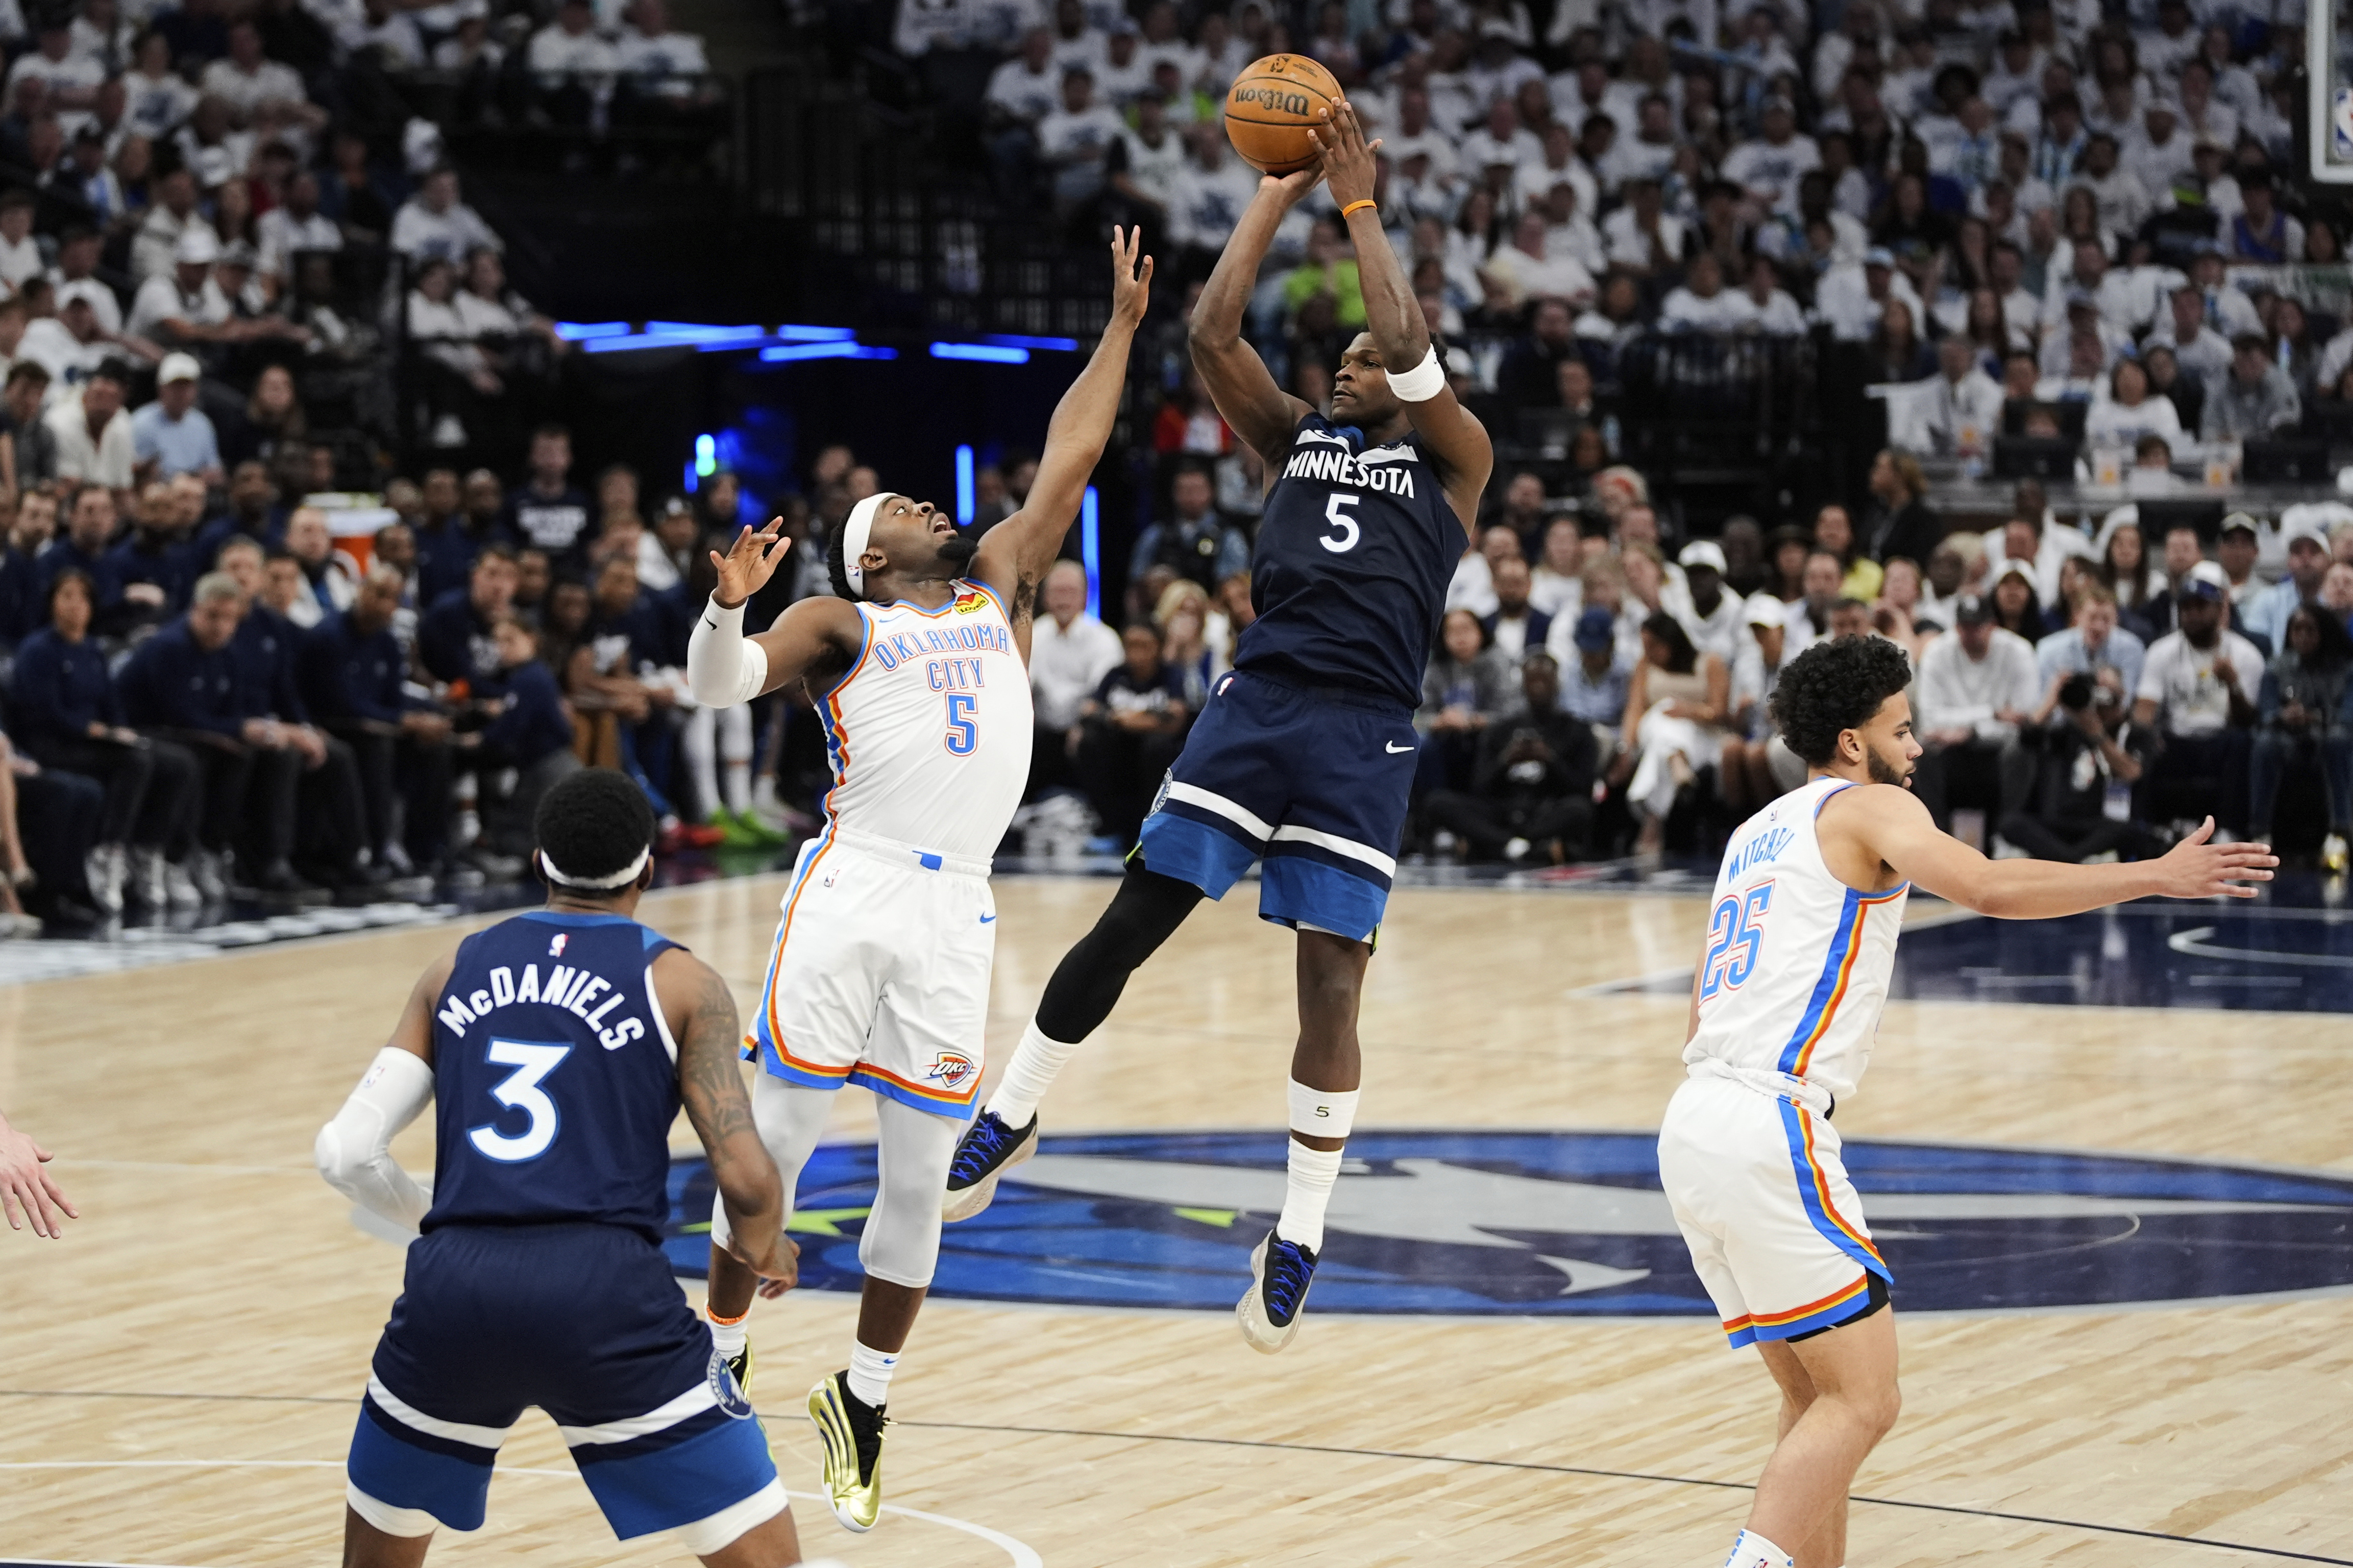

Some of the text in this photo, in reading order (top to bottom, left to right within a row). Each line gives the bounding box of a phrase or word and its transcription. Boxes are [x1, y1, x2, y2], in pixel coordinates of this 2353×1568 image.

[1235, 88, 1310, 117] Wilson
[1282, 450, 1414, 499] MINNESOTA
[1319, 492, 1361, 554] 5
[873, 623, 1010, 671] OKLAHOMA
[926, 657, 984, 691] CITY
[945, 692, 978, 757] 5
[1698, 878, 1776, 1008] 25
[438, 963, 645, 1051] McDANIELS
[930, 1061, 968, 1076] OKC
[466, 1036, 576, 1163] 3
[1314, 1106, 1330, 1117] 5
